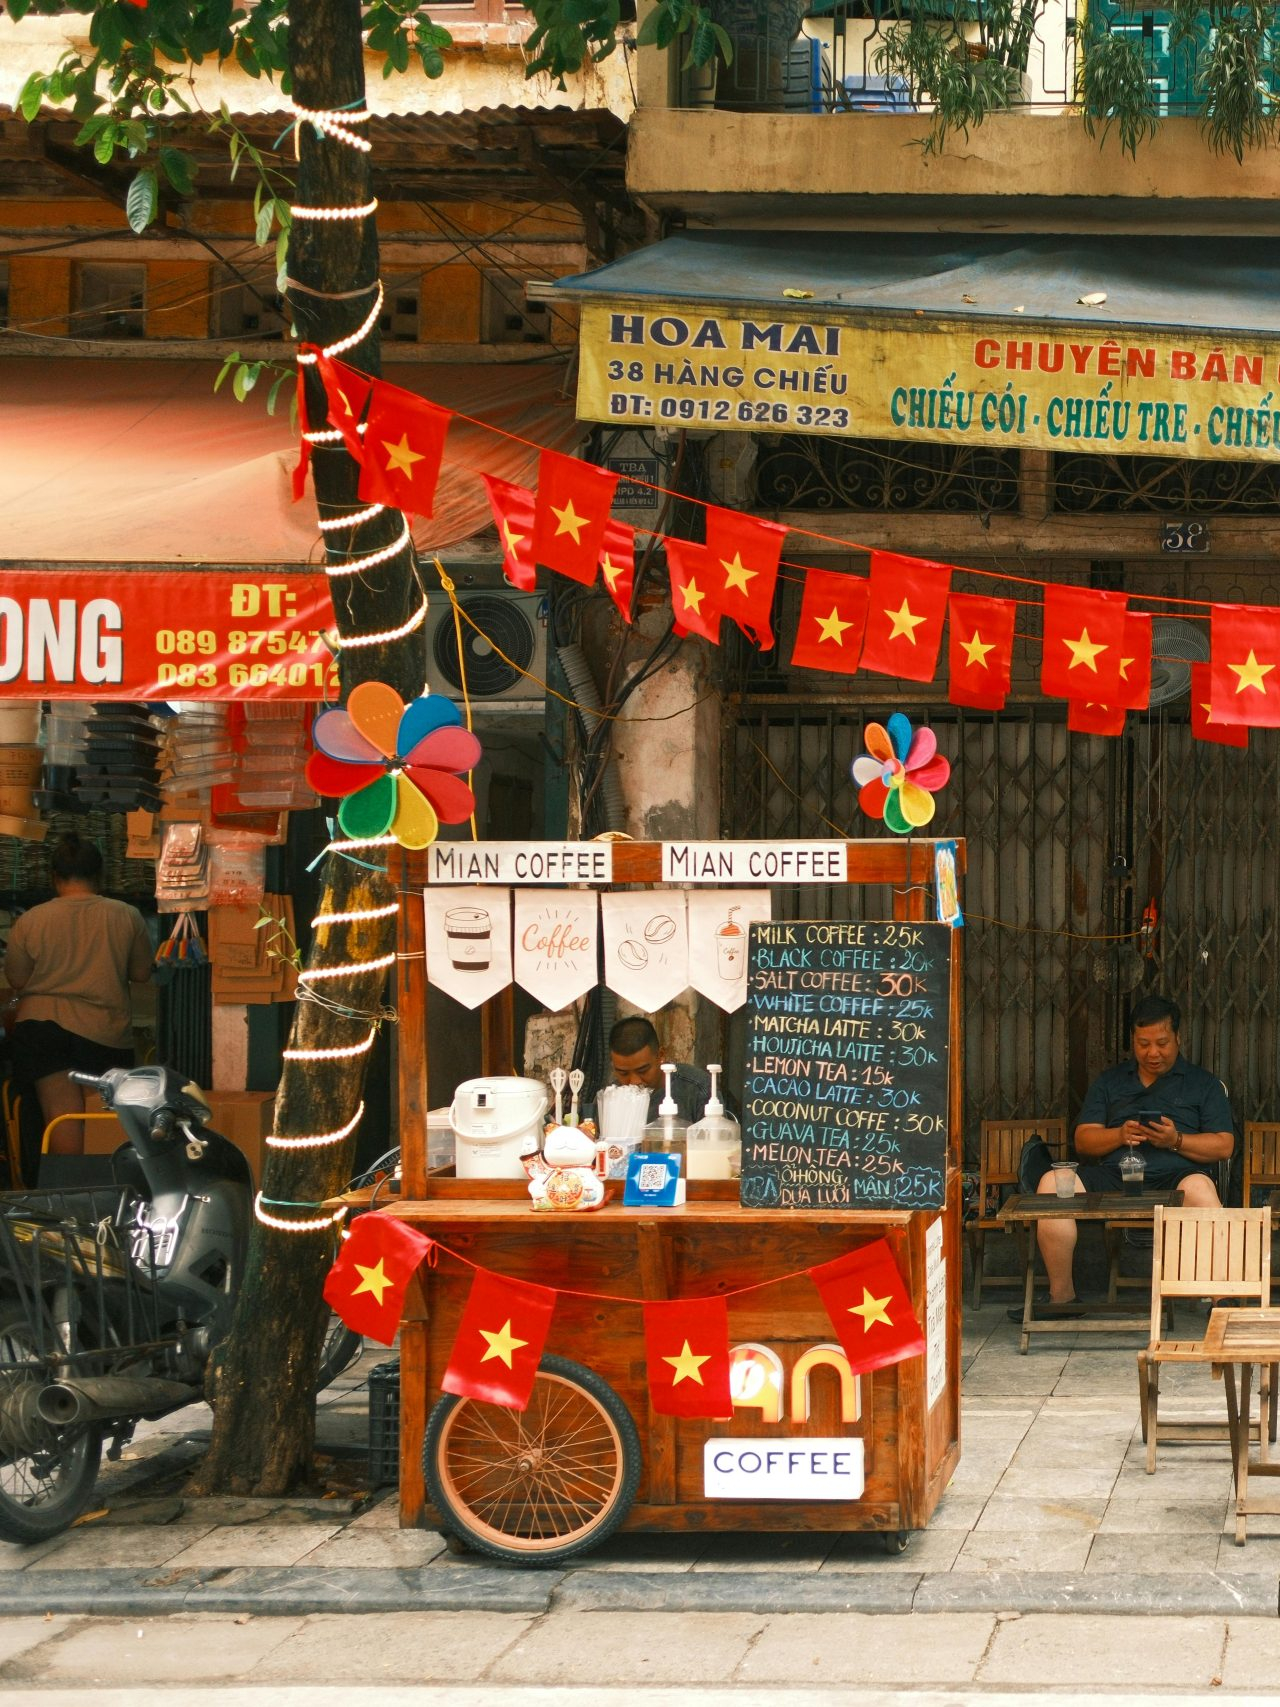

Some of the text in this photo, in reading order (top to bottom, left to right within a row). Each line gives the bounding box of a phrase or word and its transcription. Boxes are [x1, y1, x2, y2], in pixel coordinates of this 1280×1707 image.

[610, 314, 841, 356] HOA MAI
[973, 338, 1156, 379] CHUYÊN
[1170, 347, 1264, 387] BÁN
[608, 358, 848, 395] 38 HÀNG CHIẾU
[610, 393, 849, 428] ĐT: 0912 626 323
[891, 372, 974, 433] CHIẾU
[981, 381, 1028, 434] CÓI
[1047, 381, 1130, 440] CHIẾU
[1138, 401, 1188, 444] TRE
[1166, 522, 1203, 549] 38
[230, 583, 297, 617] ĐT:
[156, 630, 340, 656] 089 87547
[158, 664, 217, 687] 083
[515, 852, 605, 878] COFFEE
[749, 851, 841, 877] COFFEE
[522, 923, 590, 958] Coffee
[757, 926, 797, 945] MILK
[806, 925, 867, 945] COFFEE
[757, 948, 812, 969] BLACK
[821, 949, 884, 970] COFFEE
[755, 970, 799, 990] SALT
[754, 992, 815, 1012] WHITE
[820, 995, 884, 1016] COFFEE
[754, 1015, 820, 1035] MATCHA
[824, 1018, 872, 1038] LATTE
[836, 1041, 885, 1062] LATTE
[753, 1056, 811, 1077] LEMON
[815, 1061, 848, 1081] TEA
[752, 1076, 811, 1097] CACAO
[816, 1083, 865, 1105] LATTE
[752, 1098, 834, 1122] COCONUT
[752, 1121, 815, 1144] GUAVA
[819, 1126, 850, 1149] TEA
[753, 1142, 812, 1164] MELON
[816, 1148, 852, 1167] TEA
[714, 1451, 850, 1475] COFFEE
